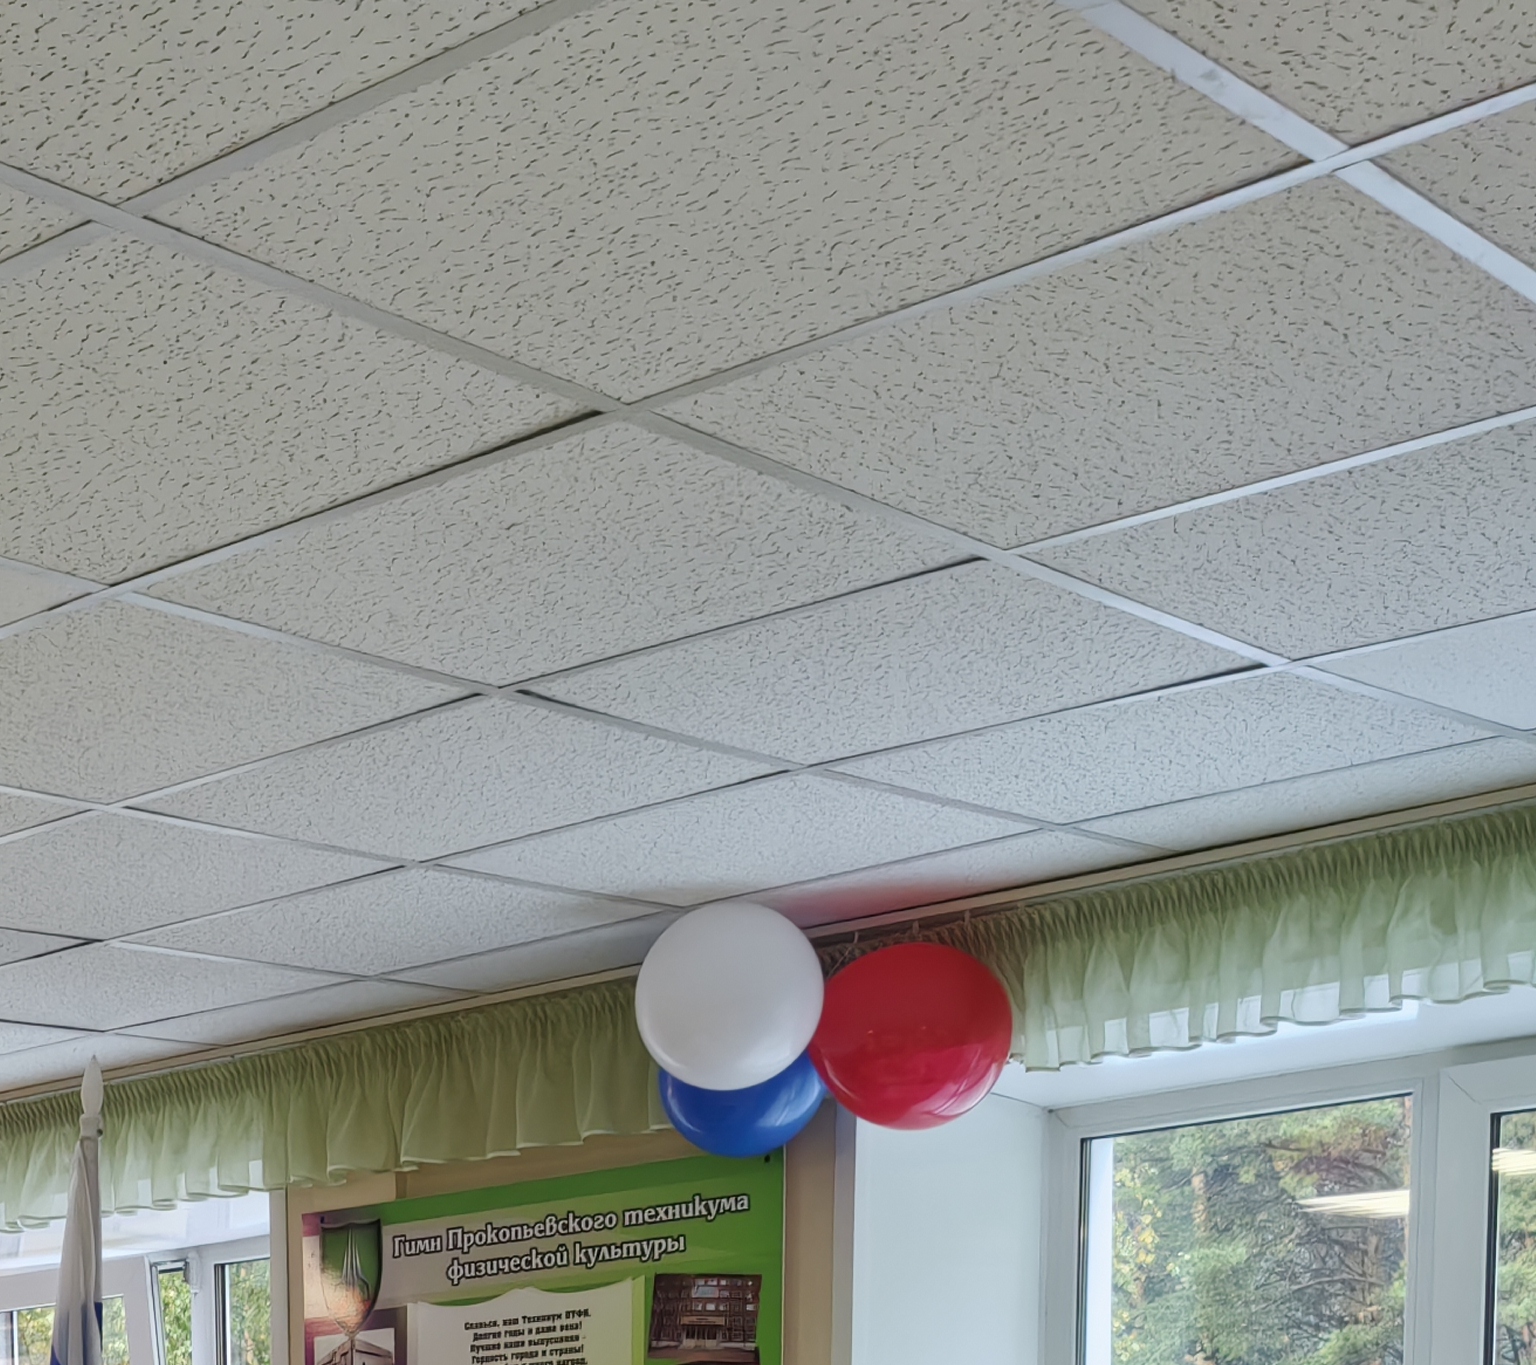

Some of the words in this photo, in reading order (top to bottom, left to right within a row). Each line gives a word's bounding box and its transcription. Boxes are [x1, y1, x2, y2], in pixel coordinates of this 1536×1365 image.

[393, 1233, 442, 1258] Гимн
[446, 1210, 618, 1254] Прокопьевского
[623, 1193, 750, 1228] техникума
[446, 1243, 569, 1286] физической
[574, 1234, 686, 1269] культуры
[504, 1328, 525, 1338] годы
[522, 1312, 562, 1324] Техникум
